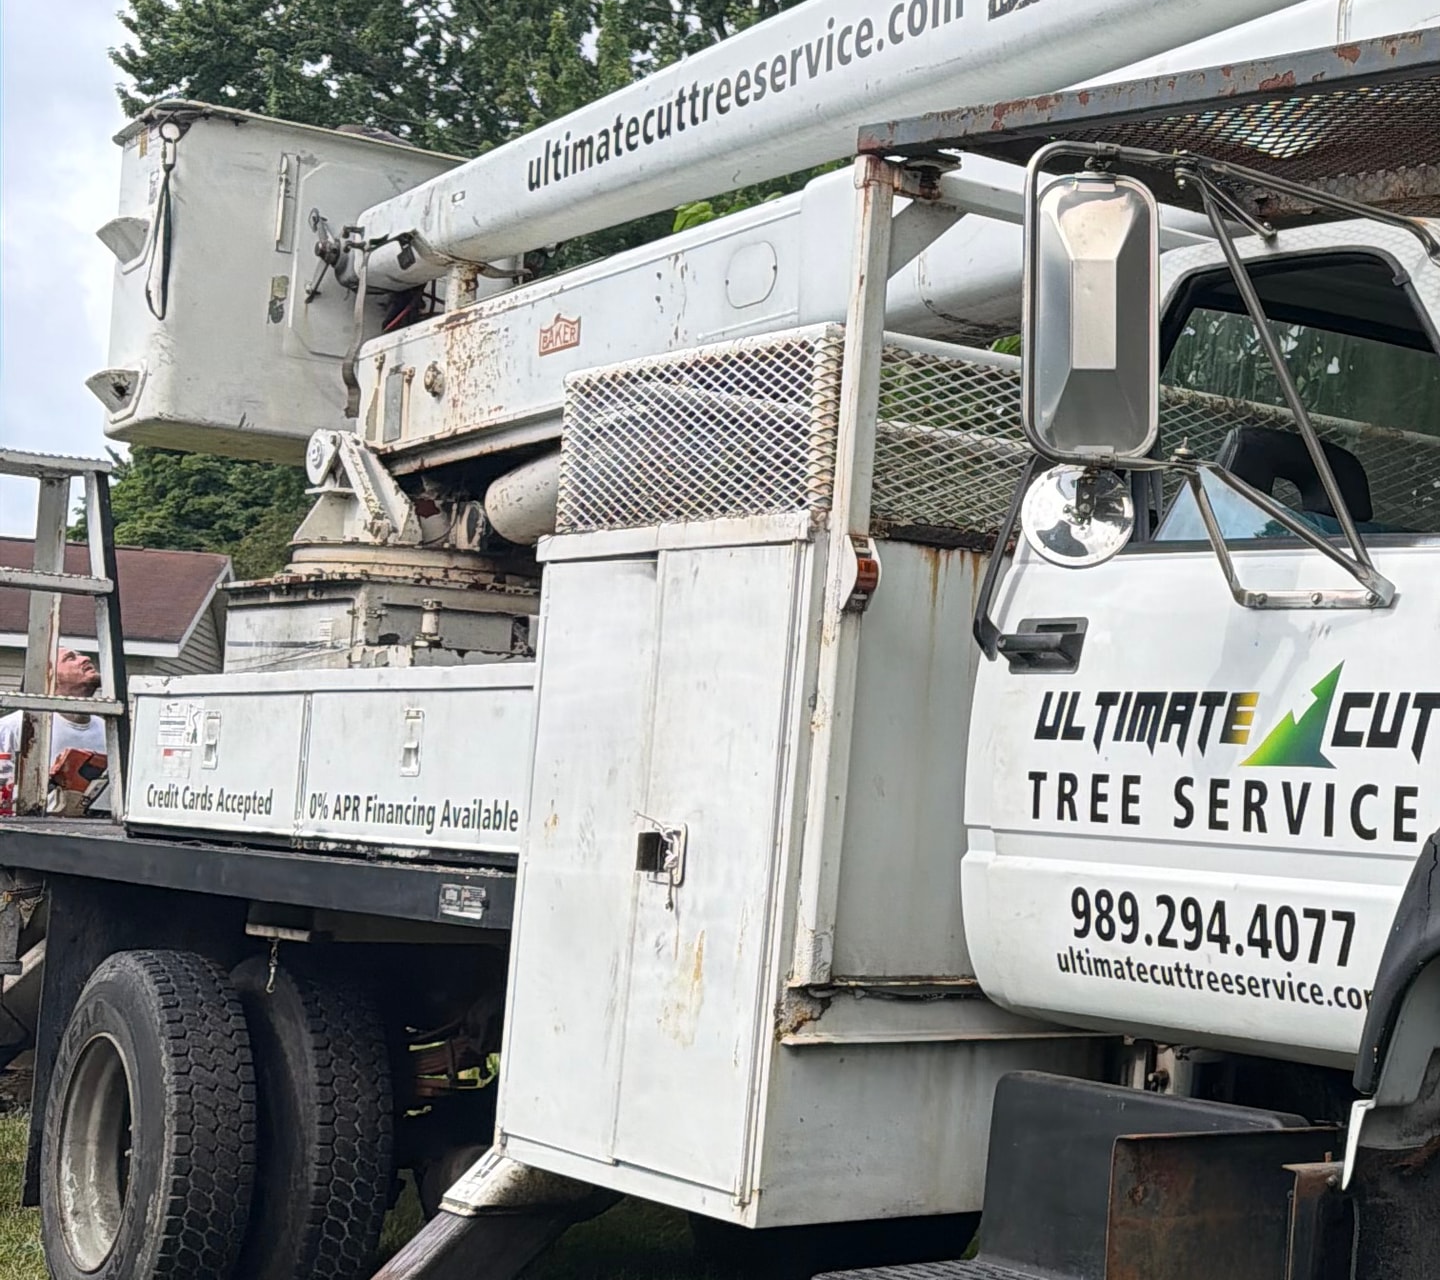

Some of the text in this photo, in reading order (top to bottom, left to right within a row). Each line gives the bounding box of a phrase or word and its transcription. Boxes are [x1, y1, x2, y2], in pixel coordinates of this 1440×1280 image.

[541, 323, 576, 350] BAKER
[1034, 691, 1260, 758] ULTIMATE
[147, 783, 274, 821] Credit Cards Accepted
[309, 792, 519, 835] 0% APR Financing Available
[1028, 771, 1419, 843] TREE SERVICE
[1071, 886, 1356, 967] 989.294.4077
